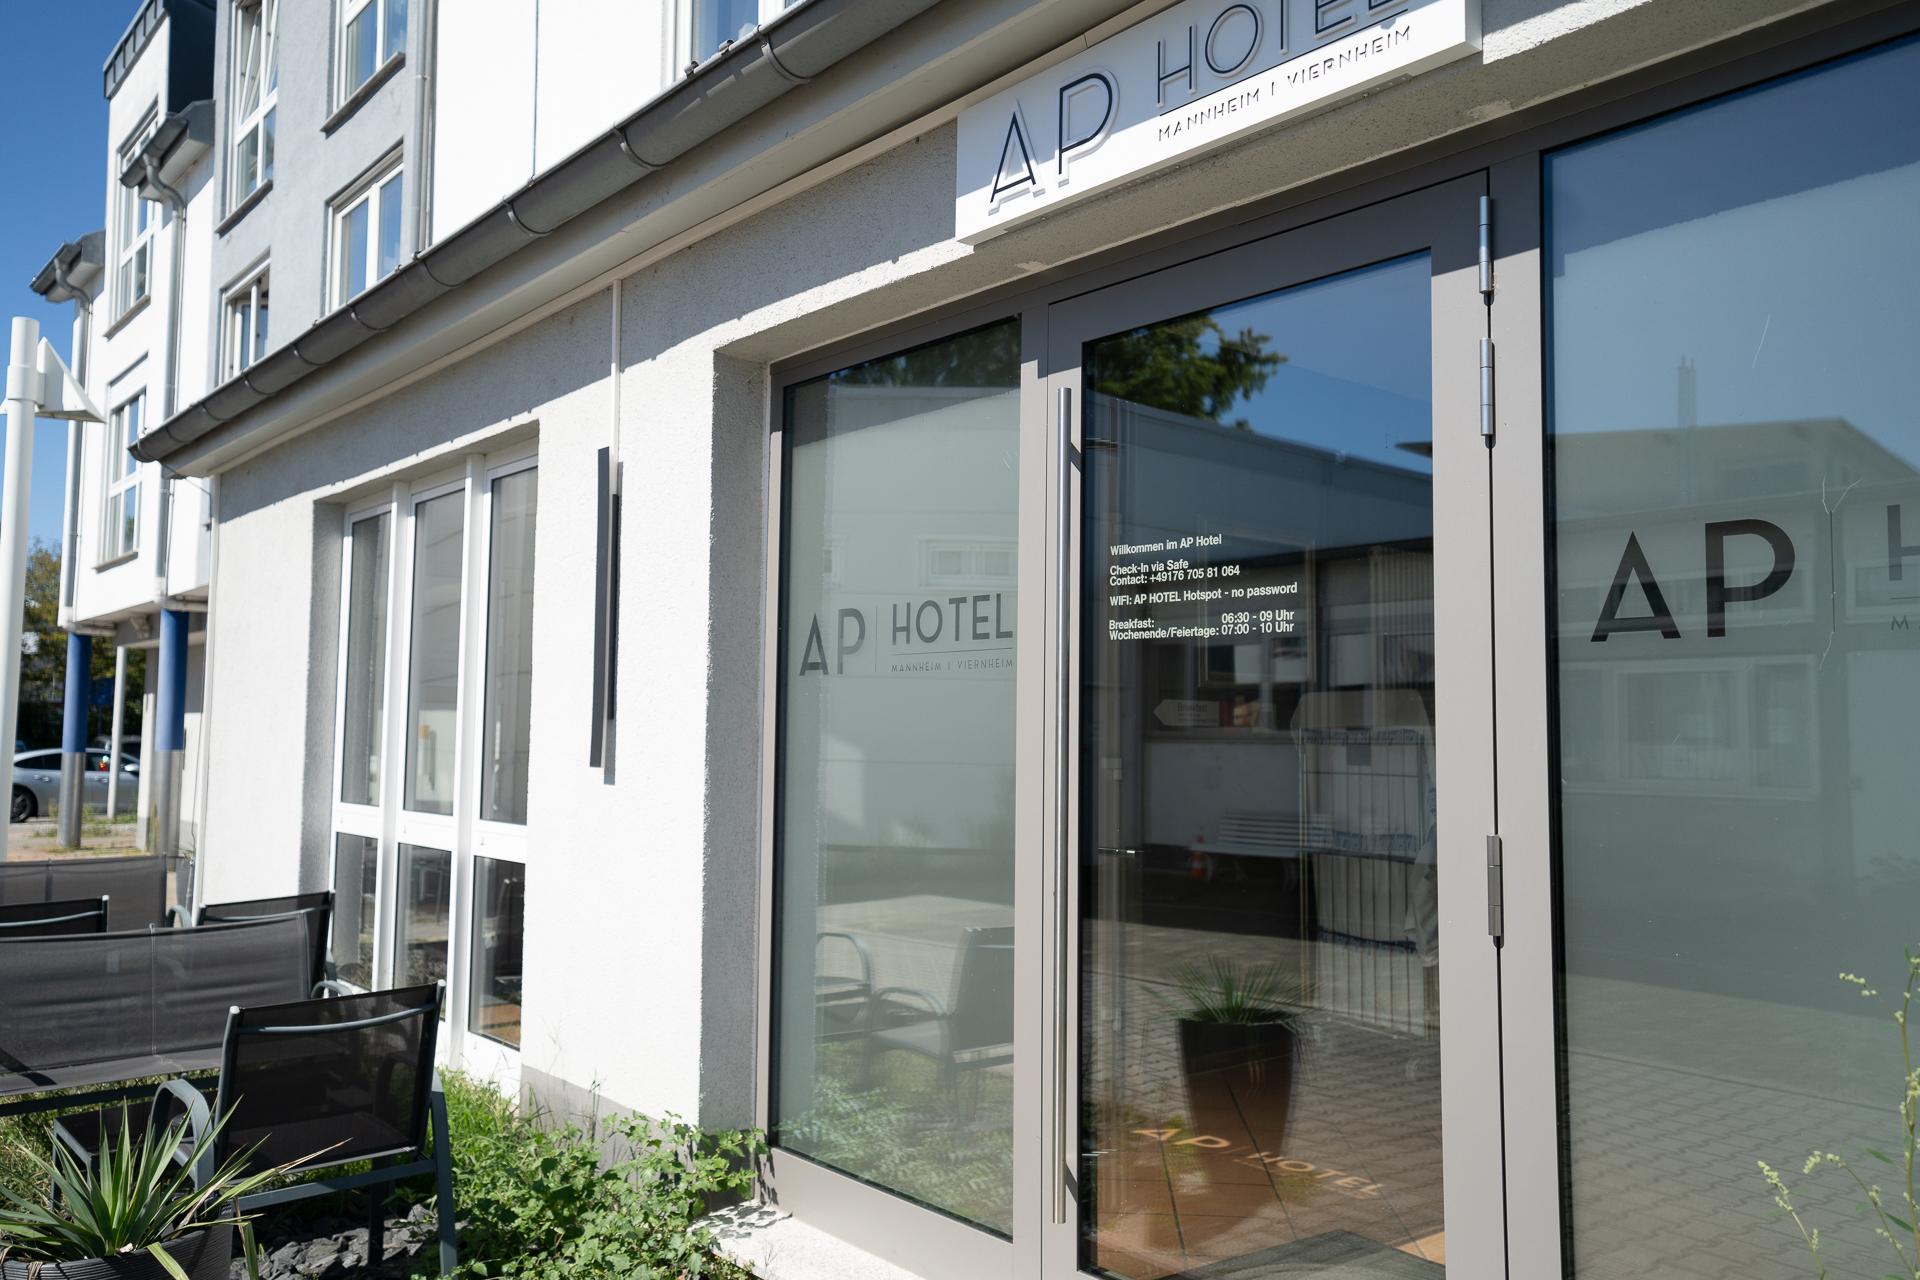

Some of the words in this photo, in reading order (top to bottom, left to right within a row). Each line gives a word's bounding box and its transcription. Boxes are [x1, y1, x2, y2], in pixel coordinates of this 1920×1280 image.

[1157, 88, 1260, 142] MANNHEIM
[1287, 25, 1411, 88] VIERNHEIM
[990, 72, 1115, 203] AP
[1110, 543, 1164, 555] Willkommen
[1166, 540, 1178, 550] im
[1180, 537, 1194, 548] AP
[1196, 534, 1222, 546] Hotel
[1110, 562, 1149, 576] Check-In
[1151, 562, 1164, 571] via
[1167, 559, 1189, 570] Safe
[1110, 574, 1148, 586] Contact:
[1149, 570, 1184, 583] +49176
[1187, 569, 1204, 580] 705
[1207, 567, 1218, 578] 81
[1222, 565, 1240, 576] 064
[1590, 518, 1796, 642] AP
[1110, 595, 1132, 606] WIFI:
[1134, 594, 1146, 605] AP
[1149, 592, 1181, 603] HOTEL
[1183, 589, 1222, 601] Hotspot
[1231, 588, 1244, 597] no
[1247, 582, 1298, 598] password
[1109, 618, 1154, 630] Breakfast:
[1222, 612, 1250, 624] 06:30
[1259, 610, 1273, 621] 09
[1275, 609, 1294, 621] Uhr
[799, 607, 866, 676] AP
[891, 592, 1014, 646] HOTEL
[1109, 627, 1219, 640] Wochenende/Feiertage:
[1222, 623, 1250, 635] 07:00
[1260, 622, 1273, 633] 10
[1275, 622, 1294, 632] Uhr
[891, 662, 942, 673] MANNHEIM
[957, 658, 1014, 670] VIERNHEIM
